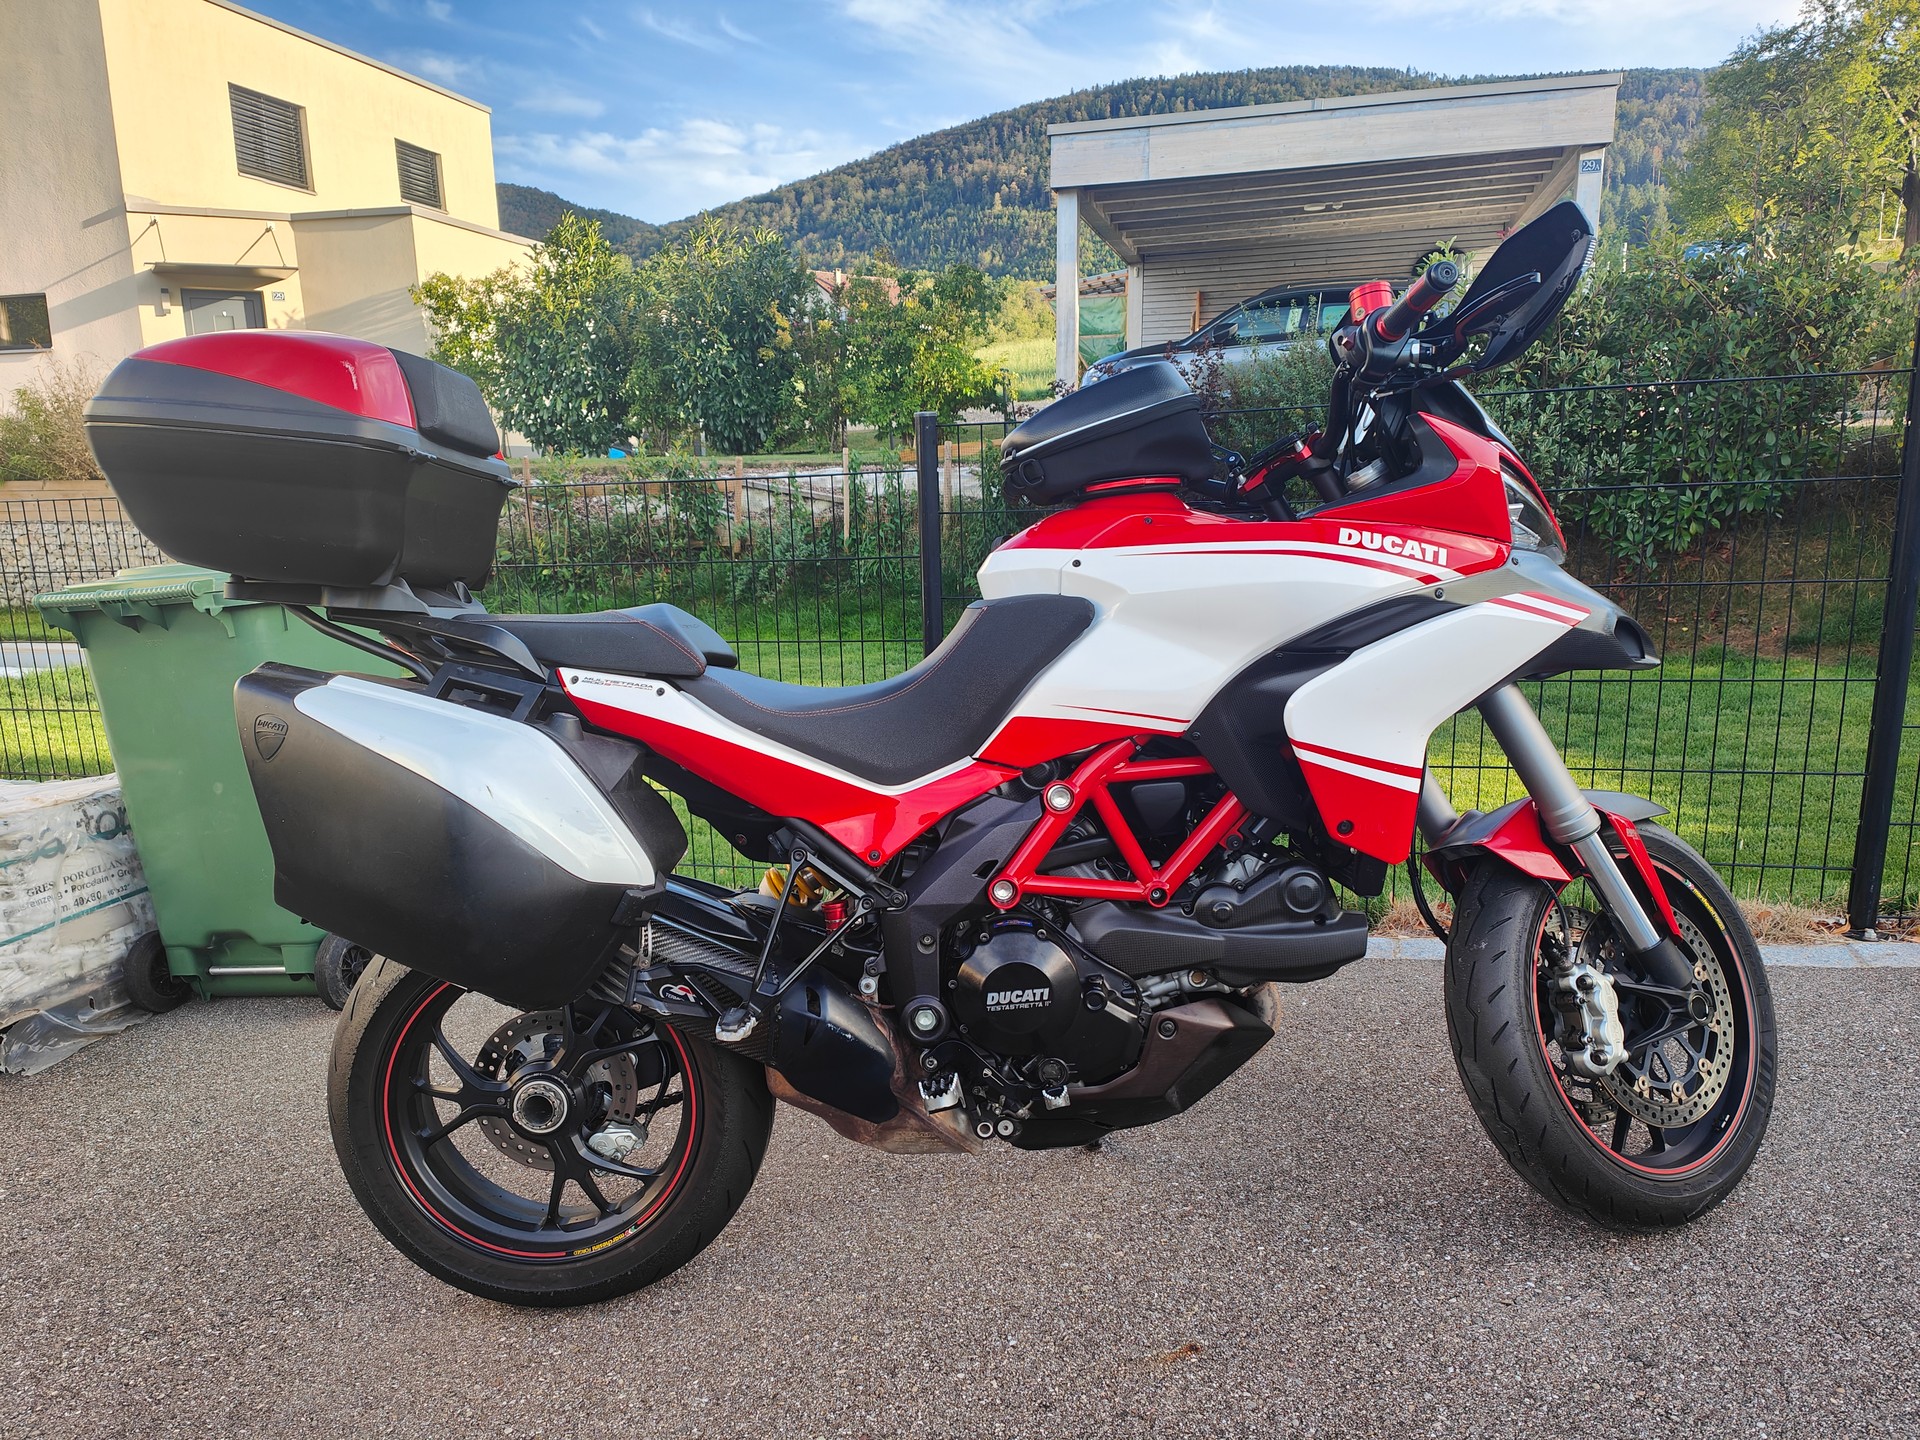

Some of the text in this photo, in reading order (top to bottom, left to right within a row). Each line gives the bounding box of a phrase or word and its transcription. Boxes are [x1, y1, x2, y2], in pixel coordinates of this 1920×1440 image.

[1582, 160, 1600, 171] 29A
[1338, 527, 1448, 566] DUCATI
[257, 719, 286, 732] DUCATI
[26, 881, 56, 898] GRES
[71, 875, 109, 893] Porcelain
[73, 890, 102, 908] 40x80
[986, 988, 1050, 1005] DUCATI
[986, 1001, 1043, 1012] TESTASTRETTA
